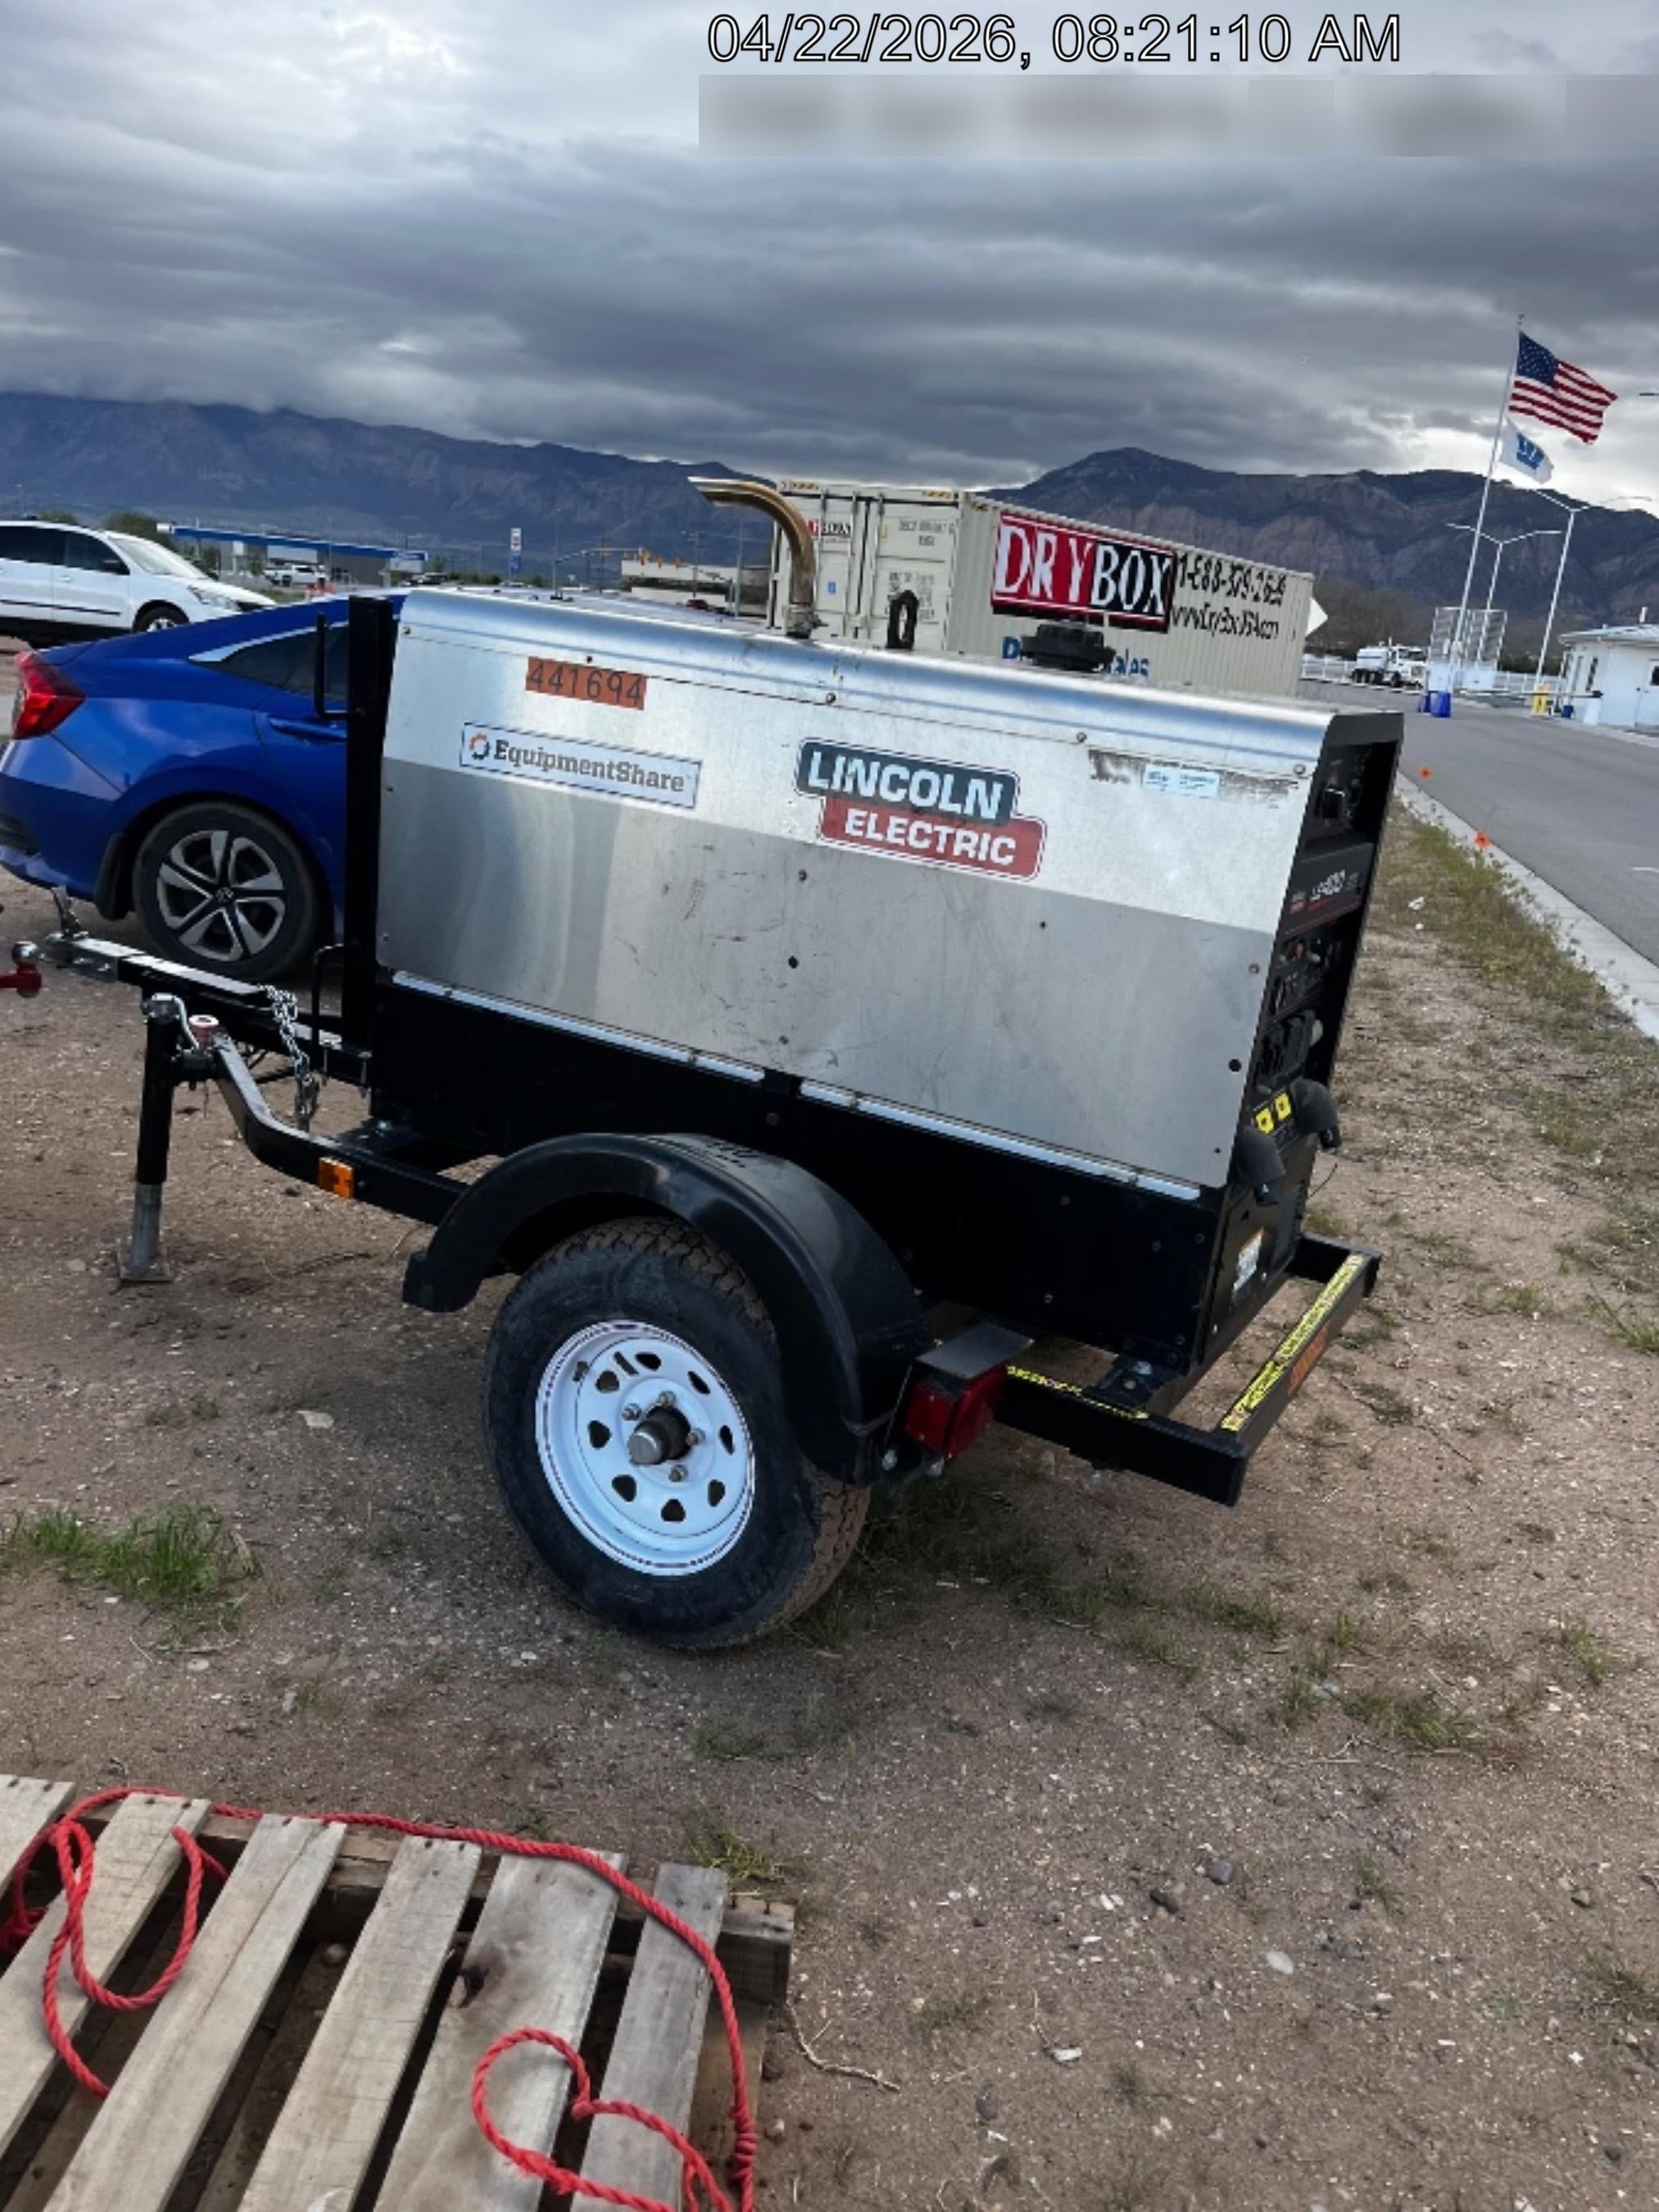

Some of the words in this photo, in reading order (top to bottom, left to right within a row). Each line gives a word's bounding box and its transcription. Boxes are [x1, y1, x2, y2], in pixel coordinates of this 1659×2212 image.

[994, 524, 1172, 614] DRYBOX
[527, 660, 643, 707] 441694
[493, 739, 685, 792] EquipmentShare
[808, 750, 1004, 819] LINCOLN
[845, 808, 1017, 866] ELECTRIC
